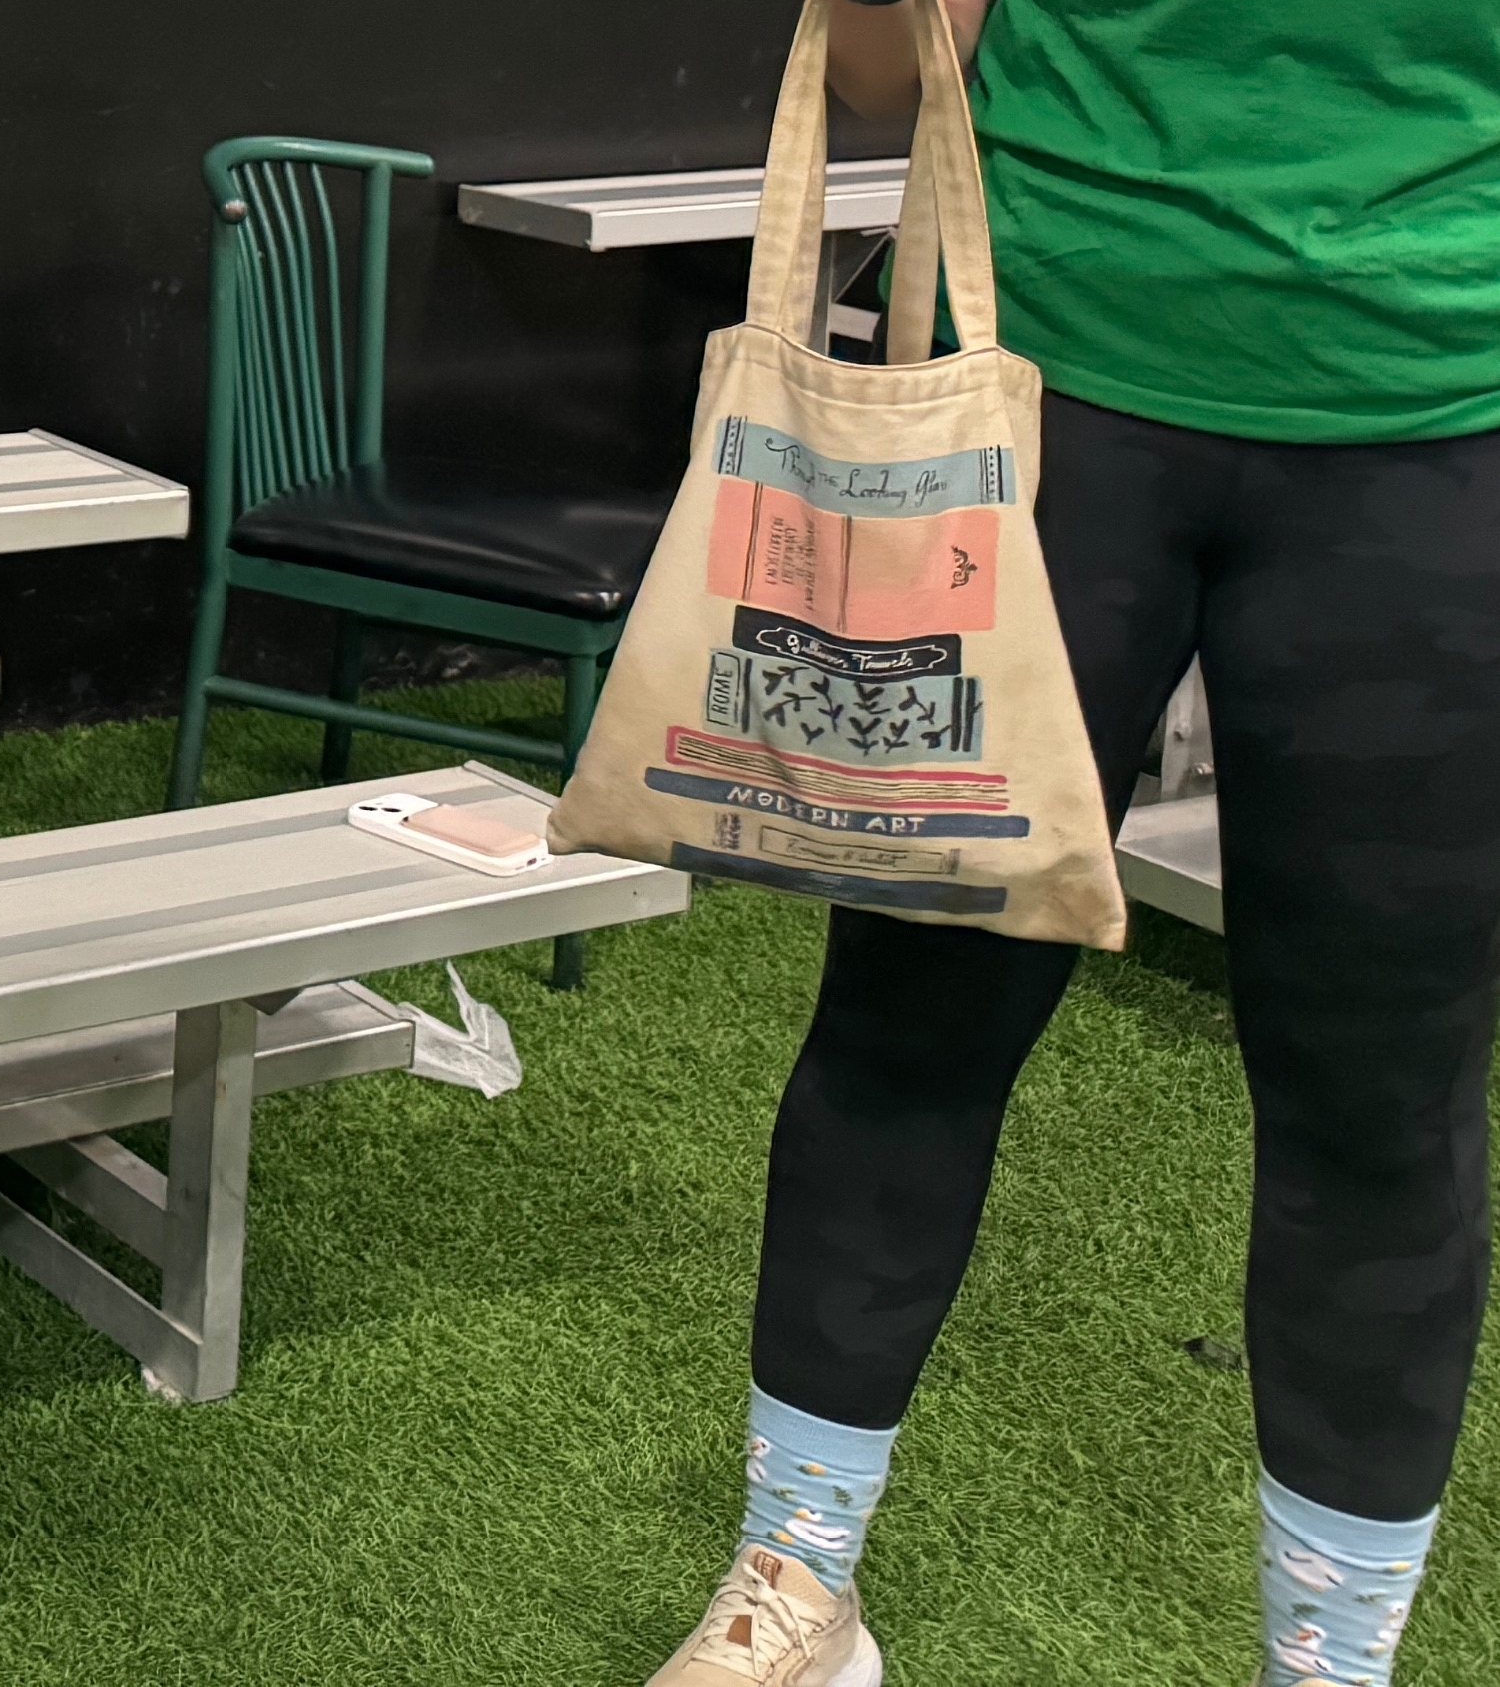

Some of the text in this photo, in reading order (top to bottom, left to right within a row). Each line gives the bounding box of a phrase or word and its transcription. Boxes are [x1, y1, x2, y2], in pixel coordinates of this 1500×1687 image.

[711, 670, 733, 715] ROME
[726, 786, 926, 834] MODERN ART
